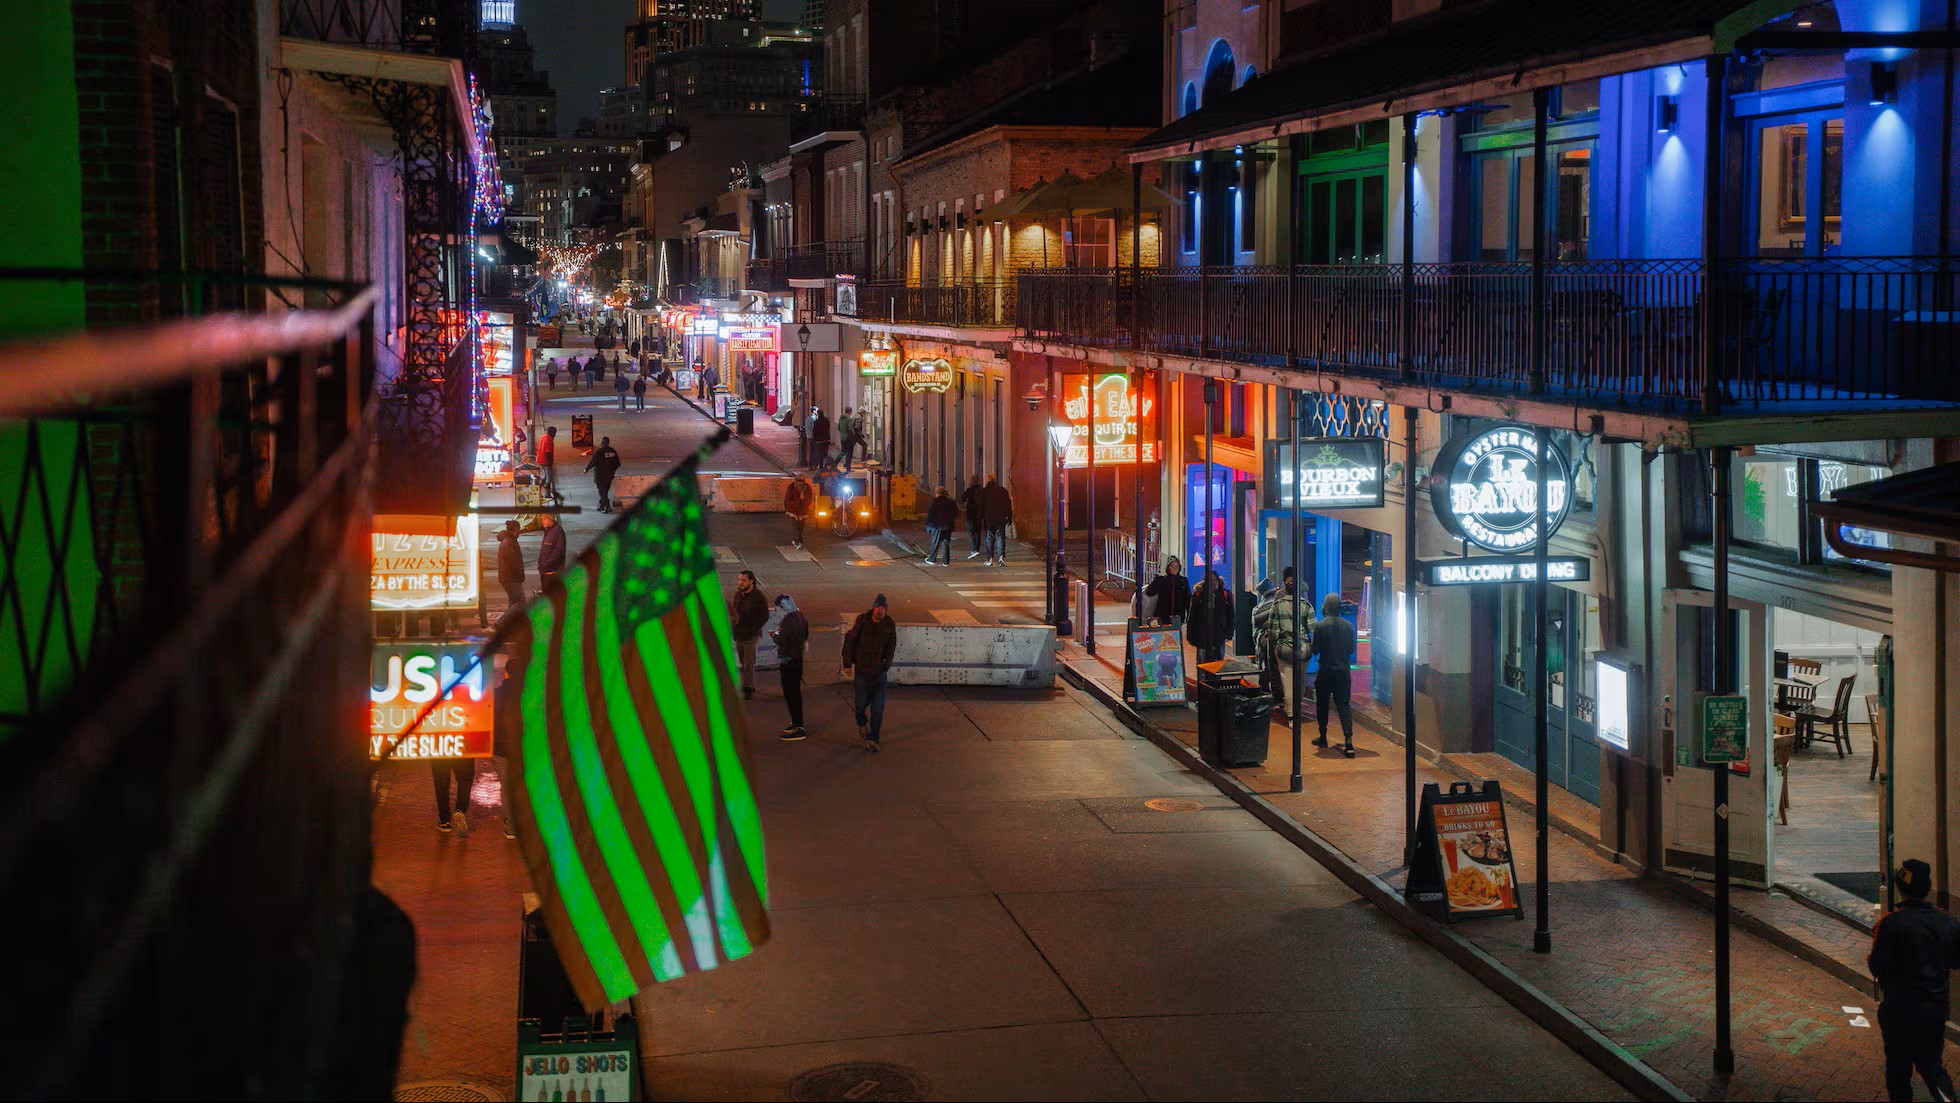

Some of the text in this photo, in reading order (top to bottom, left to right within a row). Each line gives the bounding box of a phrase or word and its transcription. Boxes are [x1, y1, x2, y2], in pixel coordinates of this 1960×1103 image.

[906, 372, 950, 382] BANDSTAND
[1108, 390, 1152, 417] EASY
[1068, 445, 1153, 460] PIZZ BY THE SLCE
[1463, 432, 1519, 466] OYSTER
[1281, 466, 1377, 485] BOURBON
[1299, 481, 1361, 498] VIEUX
[1451, 480, 1566, 514] BAYOU
[371, 556, 446, 571] EXPRESS
[1439, 564, 1514, 582] BALCONY
[387, 575, 405, 590] BY
[407, 575, 429, 590] THE
[419, 734, 464, 757] SLICE
[1456, 803, 1490, 814] BAYOU
[1444, 820, 1496, 831] DRINKS TO GO
[525, 1054, 628, 1076] JELLO SHOTS
